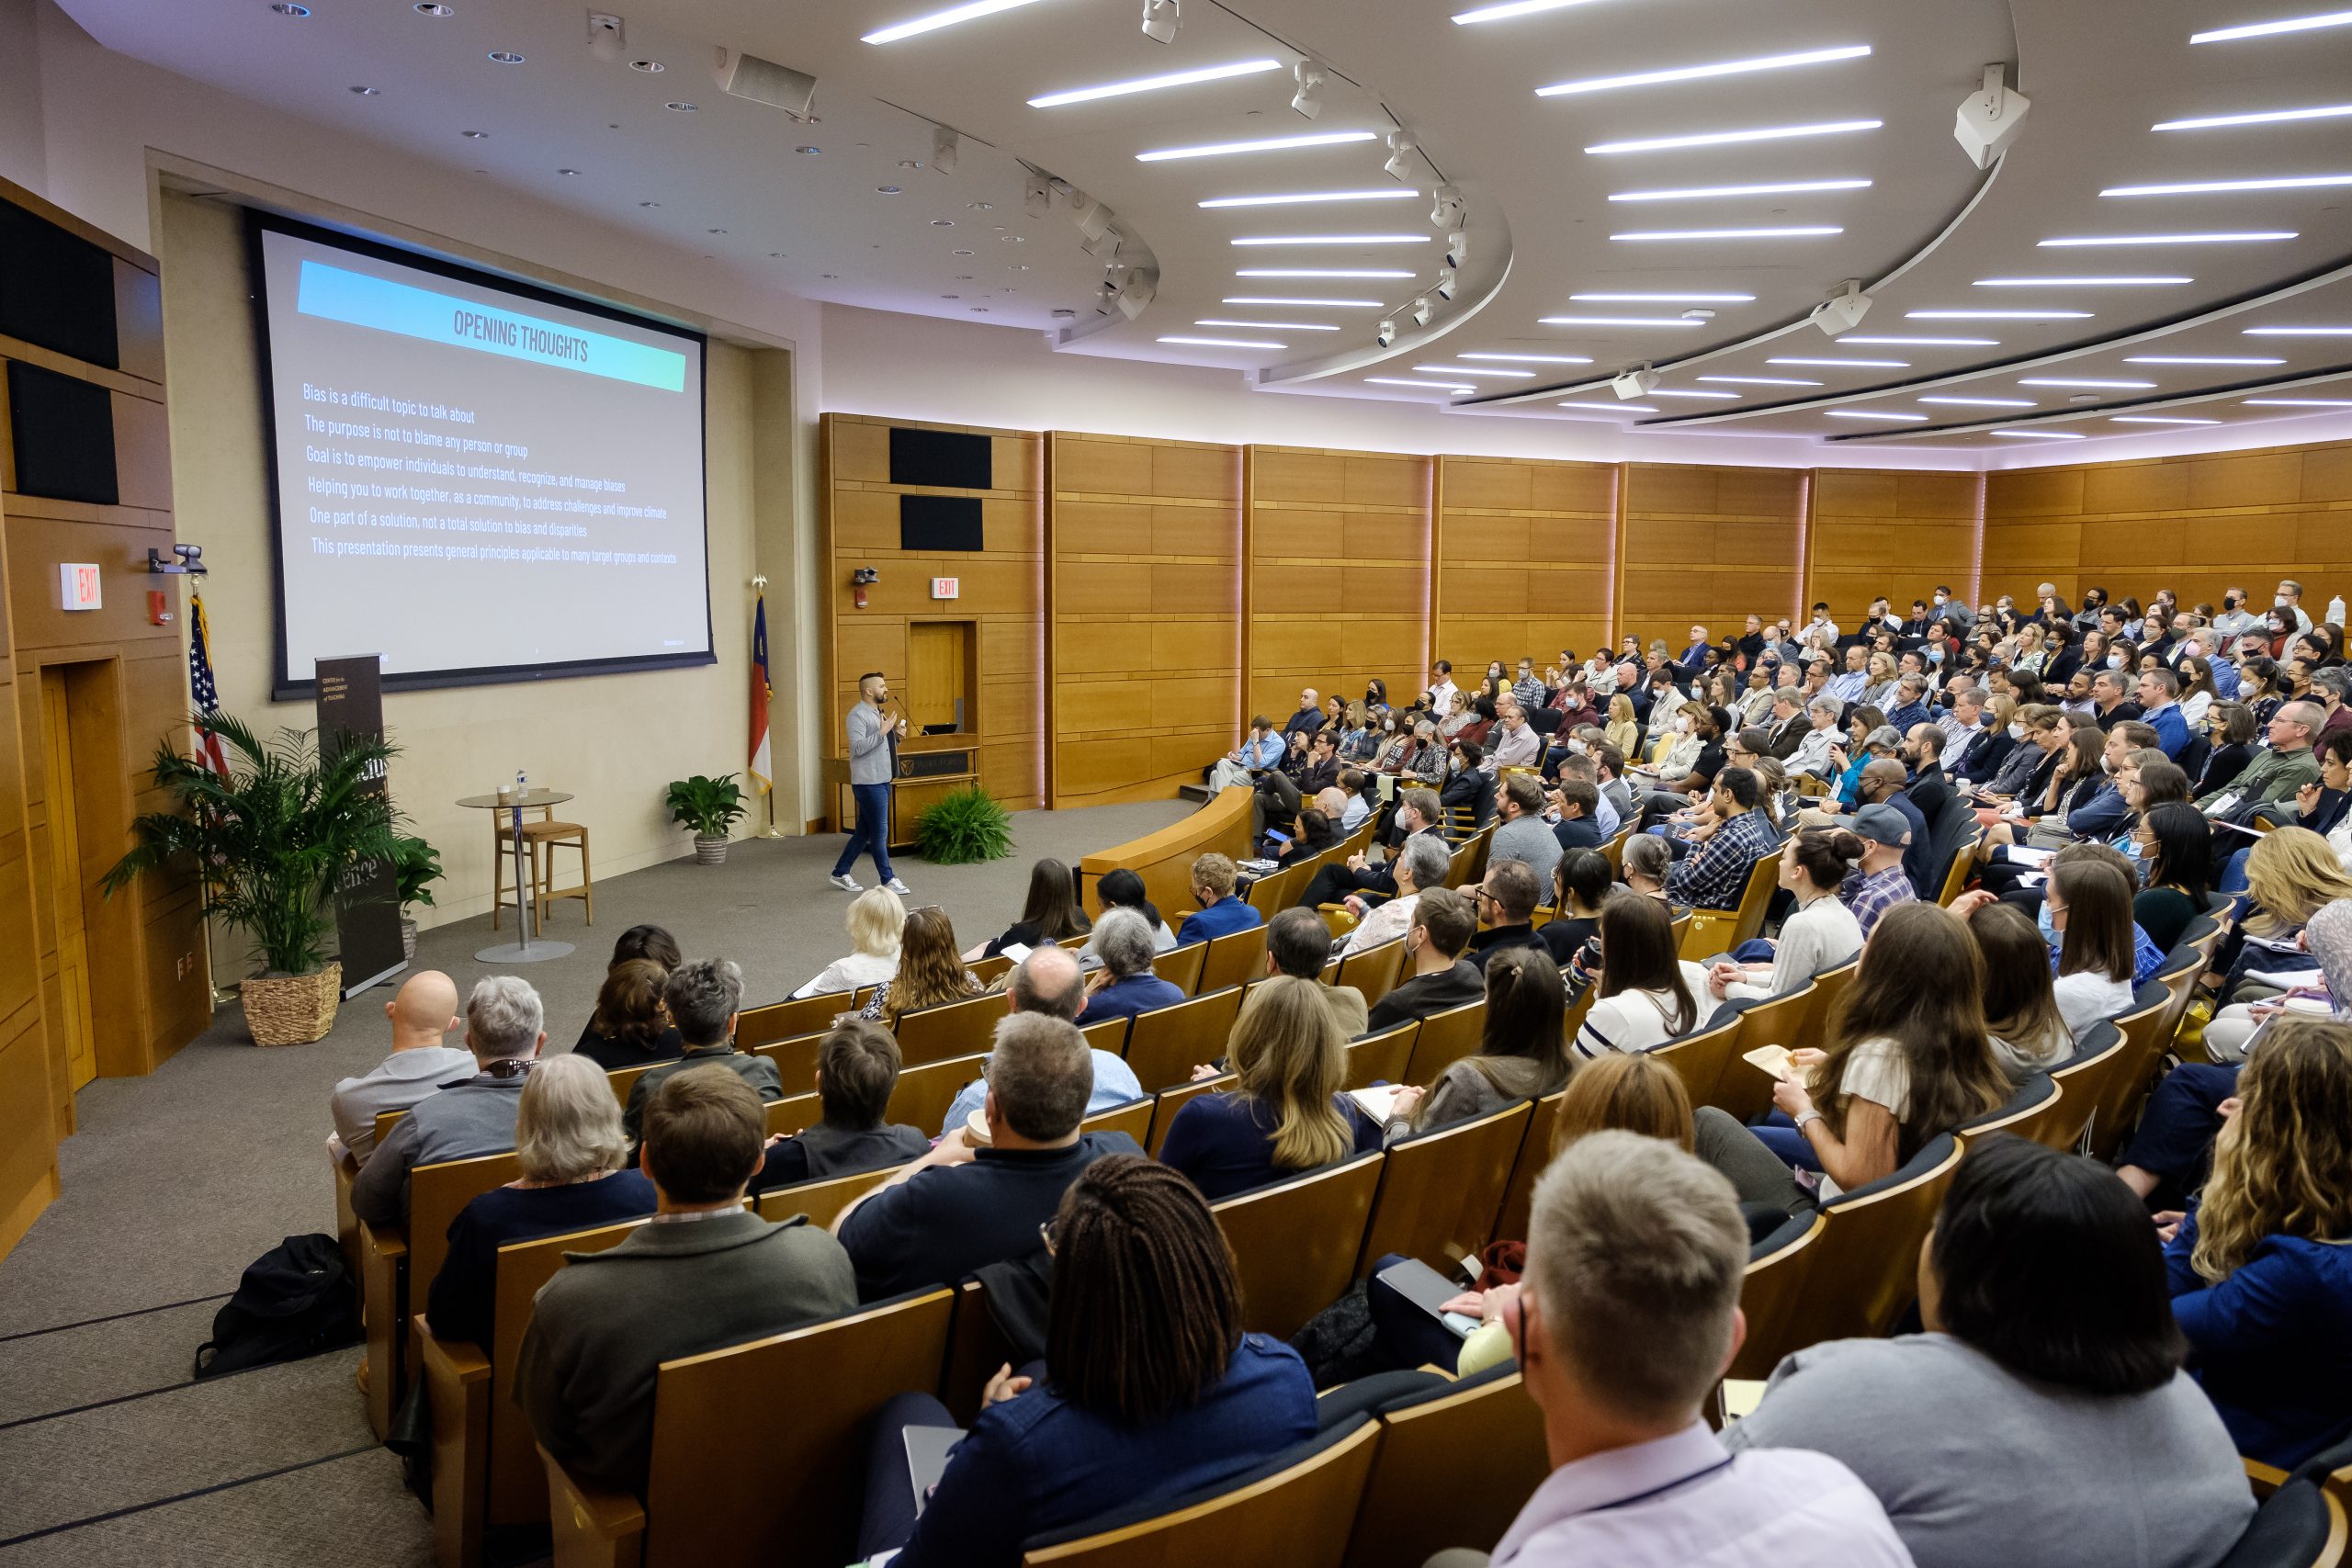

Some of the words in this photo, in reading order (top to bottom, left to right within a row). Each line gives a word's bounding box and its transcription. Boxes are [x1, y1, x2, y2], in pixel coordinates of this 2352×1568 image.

[454, 310, 517, 347] OPENING
[521, 325, 589, 363] THOUGHTS
[303, 382, 326, 402] Bias
[329, 387, 338, 404] is
[341, 392, 348, 405] a
[351, 391, 390, 412] difficult
[392, 399, 416, 418] topic
[419, 402, 428, 417] to
[431, 404, 447, 420] talk
[450, 408, 475, 424] about
[304, 414, 325, 433] The
[328, 419, 370, 439] purpose
[373, 423, 381, 439] is
[384, 427, 401, 442] not
[402, 429, 413, 444] to
[415, 429, 443, 447] blame
[445, 435, 460, 452] any
[463, 438, 492, 454] person
[494, 443, 503, 455] or
[504, 444, 528, 460] group
[306, 445, 330, 464] Goal
[333, 448, 342, 465] is
[345, 450, 355, 467] to
[357, 453, 403, 472] empower
[405, 457, 455, 476] individuals
[457, 462, 466, 478] to
[468, 465, 517, 483] understand,
[519, 470, 558, 488] recognize,
[560, 475, 573, 488] and
[575, 477, 603, 493] manage
[604, 477, 626, 492] biases
[308, 476, 348, 499] Helping
[350, 483, 369, 499] you
[371, 483, 382, 498] to
[384, 484, 408, 500] work
[410, 487, 452, 505] together,
[454, 491, 465, 503] as
[466, 492, 472, 504] a
[474, 492, 521, 512] community,
[523, 496, 531, 509] to
[533, 496, 563, 512] address
[564, 499, 602, 517] challenges
[603, 502, 616, 515] and
[617, 503, 643, 520] improve
[644, 505, 667, 519] climate
[310, 506, 331, 524] One
[334, 510, 355, 527] part
[357, 511, 368, 525] of
[370, 513, 378, 526] a
[379, 512, 420, 529] solution,
[423, 515, 437, 529] not
[439, 518, 446, 530] a
[447, 516, 468, 532] total
[469, 517, 503, 534] solution
[504, 521, 514, 534] to
[514, 520, 532, 534] bias
[533, 522, 548, 536] and
[548, 522, 588, 538] disparities
[311, 536, 334, 554] This
[337, 538, 401, 558] presentation
[403, 543, 444, 559] presents
[445, 544, 478, 560] general
[480, 544, 520, 562] principles
[522, 546, 561, 563] applicable
[562, 548, 570, 560] to
[571, 550, 590, 565] many
[592, 549, 613, 565] target
[614, 552, 636, 566] groups
[637, 551, 650, 564] and
[650, 551, 677, 564] contexts
[79, 568, 97, 603] EXIT
[938, 580, 956, 596] EXIT
